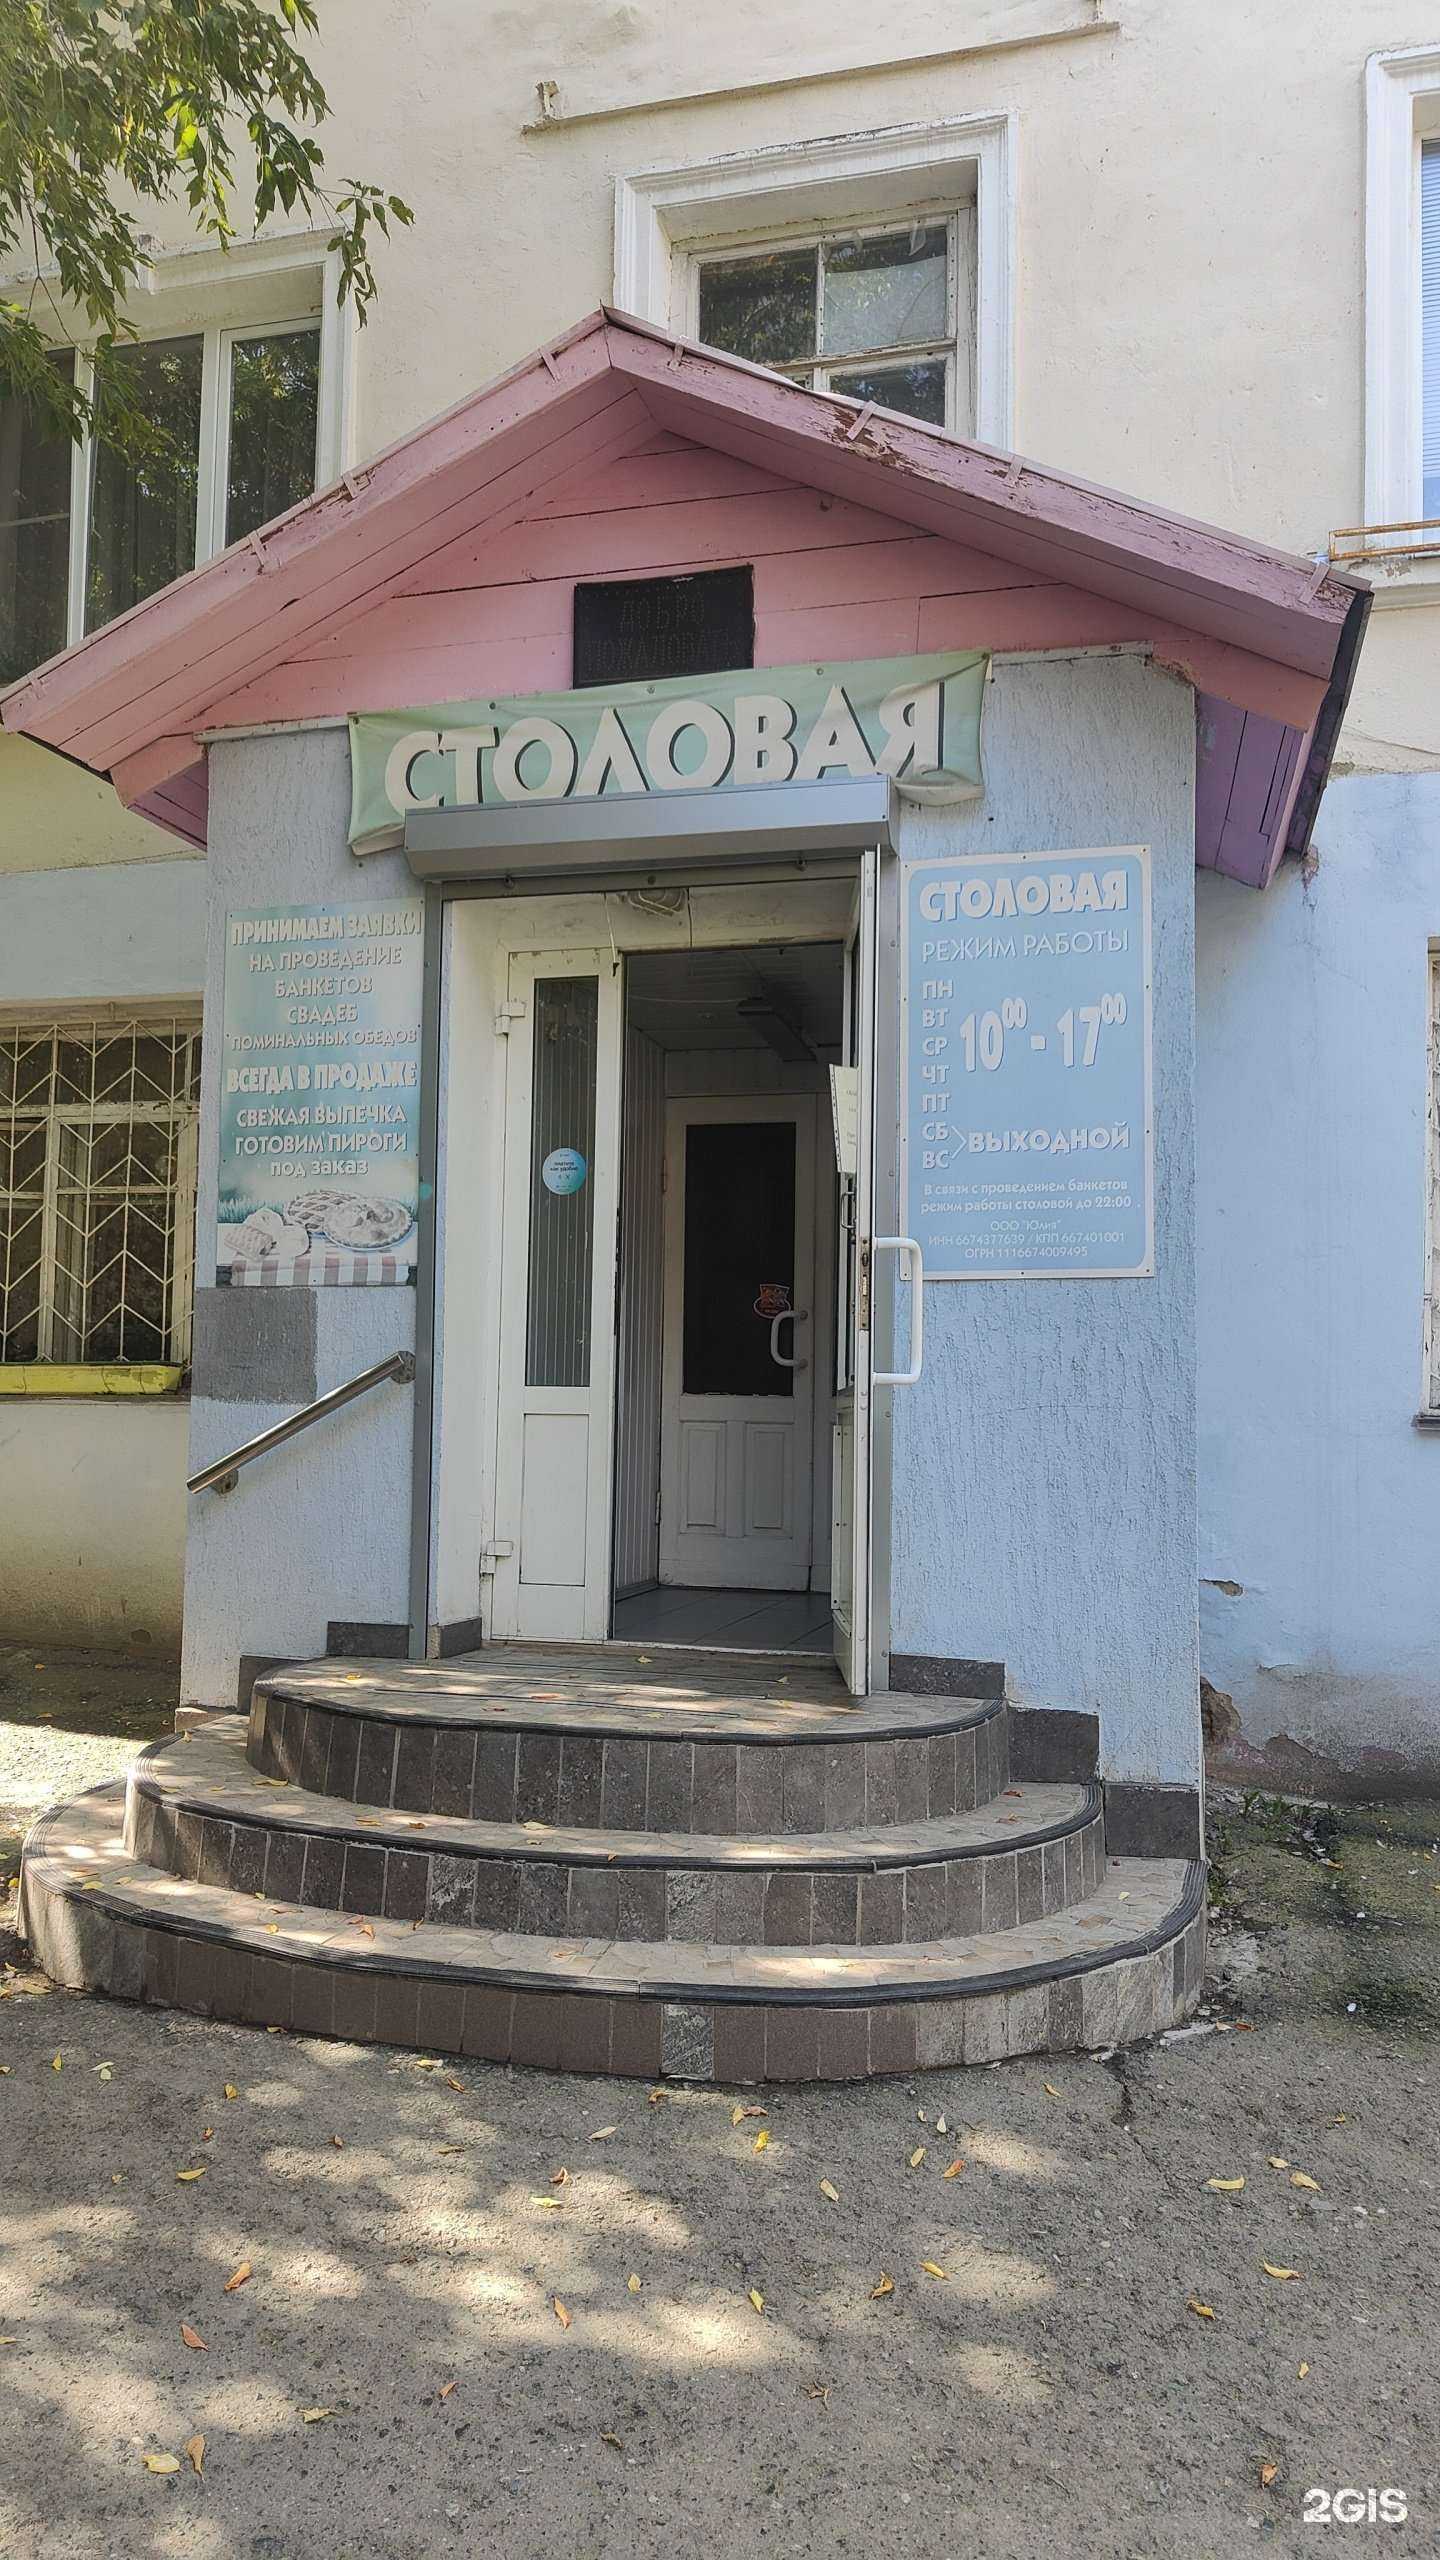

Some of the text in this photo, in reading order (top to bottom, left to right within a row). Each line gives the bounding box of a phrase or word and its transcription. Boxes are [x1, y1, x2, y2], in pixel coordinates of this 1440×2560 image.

[384, 681, 944, 815] СТОЛОВАЯ
[919, 869, 1129, 923] СТОЛОВАЯ
[232, 911, 423, 946] ПРИНИМАЕМ ЗАЯВКИ
[922, 928, 1129, 963] РЕЖИМ РАБОТЫ
[250, 946, 402, 973] НА ПРОВЕДЕНИЕ
[275, 975, 373, 998] БАНКЕТОВ
[922, 979, 954, 1000] ПН
[287, 1003, 358, 1026] СВАДЕБ
[922, 1008, 949, 1028] ВТ
[232, 1029, 417, 1051] ПОМИНАЛЬНЫХ ОБЕДОВ
[922, 1036, 949, 1057] СР
[227, 1061, 417, 1096] ВСЕГДА В ПРОДАЖЕ
[922, 1064, 950, 1085] ЧТ
[922, 1093, 950, 1114] ПТ
[236, 1104, 407, 1128] СВЕЖАЯ ВЫПЕЧКА
[922, 1121, 949, 1141] СБ
[968, 1121, 1130, 1155] ВЫХОДНОЙ
[235, 1131, 408, 1156] ГОТОВИМ ПИРОГИ
[311, 1159, 369, 1177] заказ
[922, 1150, 950, 1170] ВС
[924, 1179, 1128, 1197] В связи с проведением банкетов
[921, 1196, 1132, 1215] режим работы столовой до 22:00
[990, 1220, 1020, 1232] ООО
[928, 1235, 954, 1246] ИНН
[1035, 1232, 1059, 1244] КПП
[964, 1247, 994, 1259] ОГРН
